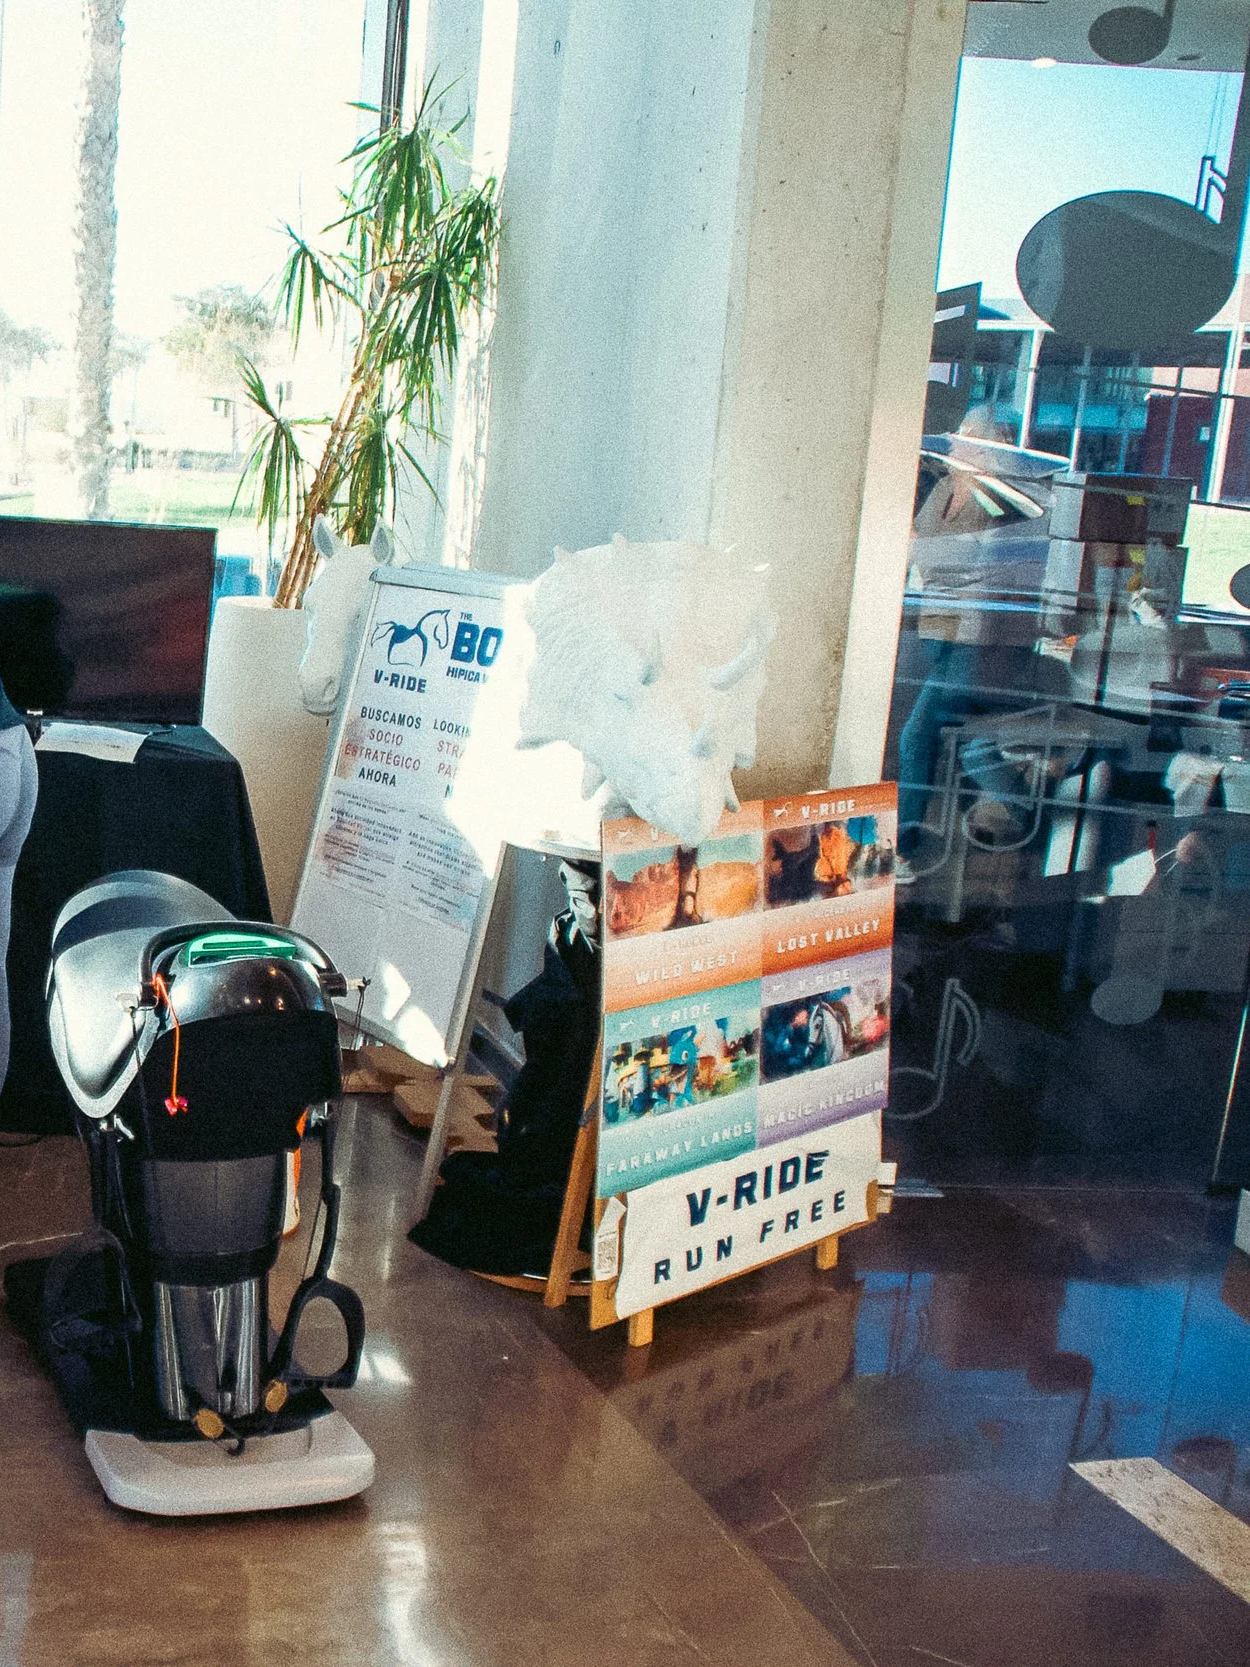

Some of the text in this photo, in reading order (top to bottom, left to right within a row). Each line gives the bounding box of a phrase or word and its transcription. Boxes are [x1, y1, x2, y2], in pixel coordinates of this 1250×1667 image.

[460, 611, 473, 621] THE
[373, 669, 428, 694] V-RIDE
[446, 666, 480, 683] HIPICA
[360, 705, 422, 730] BUSCAMOS
[368, 728, 404, 746] SOCIO
[344, 743, 421, 771] ESTRATÉGICO
[436, 740, 465, 760] STR
[357, 767, 397, 787] AHORA
[800, 800, 856, 820] V-RIDE
[776, 919, 881, 955] LOST VALLEY
[634, 950, 738, 985] WILD WEST
[605, 1140, 695, 1177] FARAWAY
[700, 1121, 754, 1148] LANDS
[685, 1149, 830, 1227] V-RIDE
[653, 1190, 846, 1285] RUN FREE
